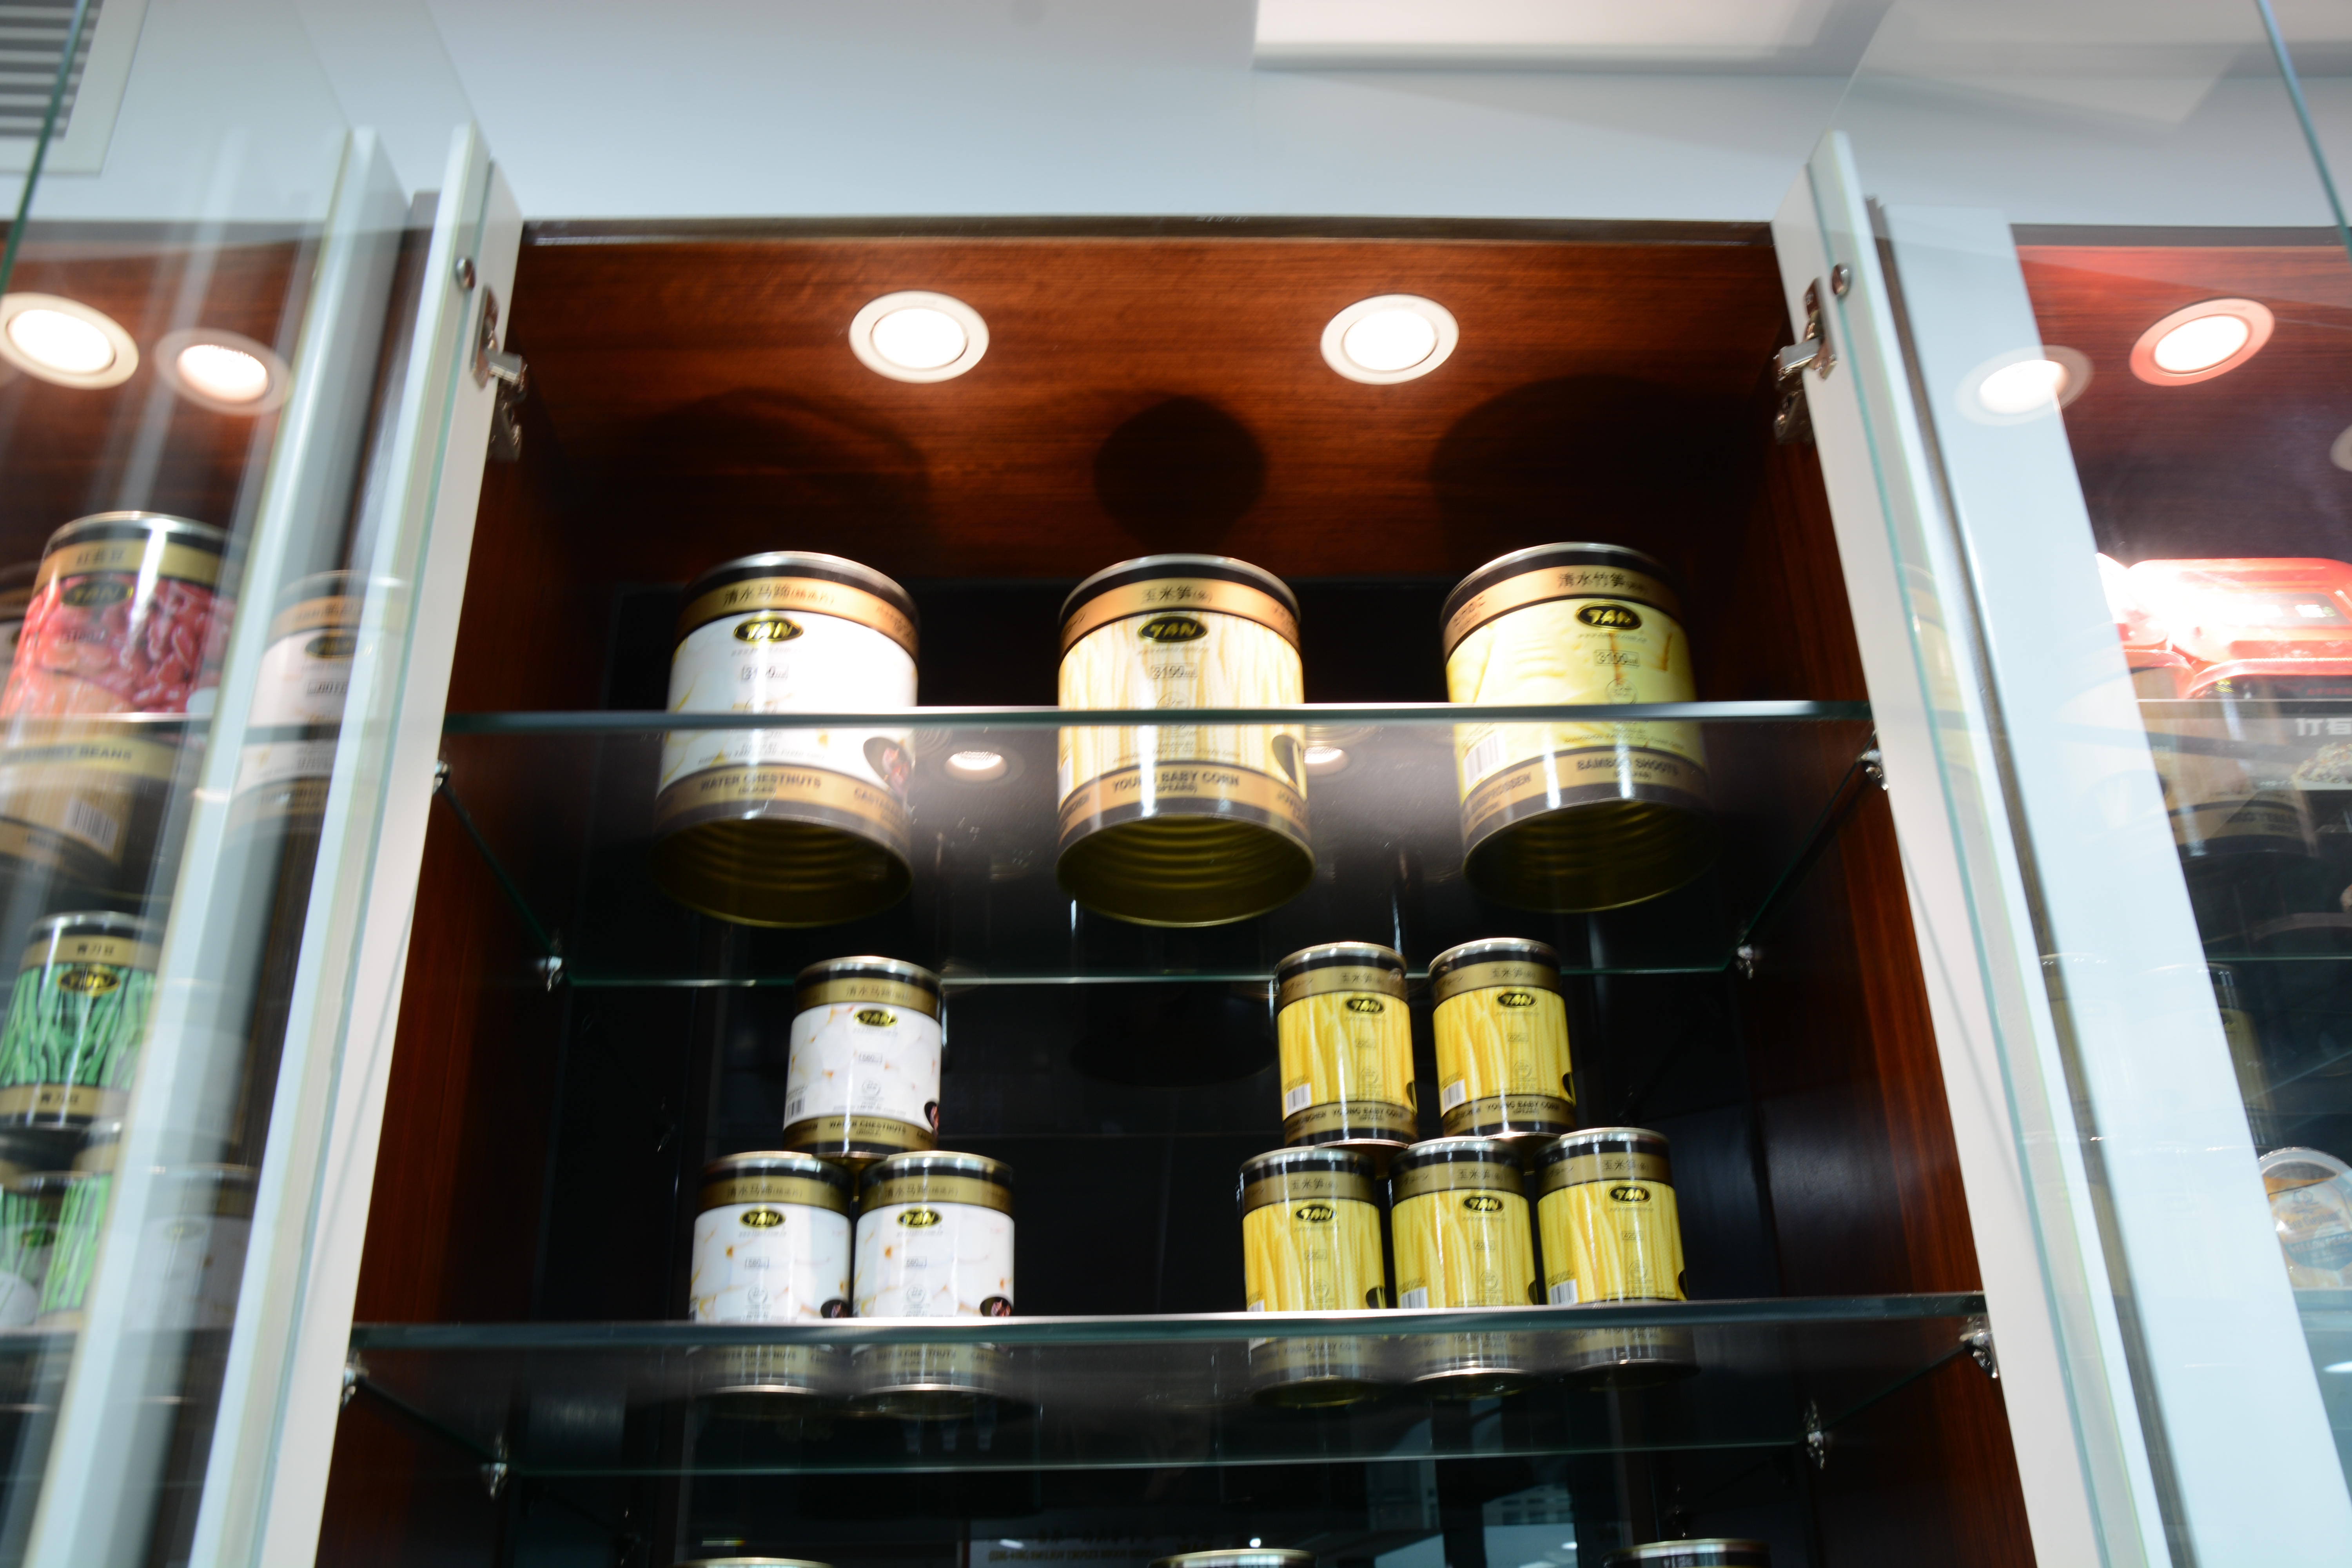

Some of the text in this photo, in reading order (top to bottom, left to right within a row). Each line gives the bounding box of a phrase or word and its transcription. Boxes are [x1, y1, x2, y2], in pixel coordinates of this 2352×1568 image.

[1587, 610, 1633, 625] TAN
[746, 622, 793, 640] TAN
[1149, 622, 1198, 638] TAN
[1577, 757, 1632, 771] BAMB
[1162, 771, 1198, 782] BABY
[1202, 771, 1239, 786] CORN
[1352, 1000, 1380, 1011] TAN
[1502, 995, 1532, 1005] TAN
[1541, 1102, 1560, 1110] CORN
[1333, 1107, 1361, 1117] YONG
[1387, 1108, 1403, 1118] CORN
[860, 1119, 906, 1134] CHESTNUTS
[1615, 1189, 1645, 1200] TAN
[1469, 1198, 1498, 1210] TAN
[748, 1212, 779, 1225] TAN
[904, 1212, 935, 1225] TAN
[1301, 1208, 1333, 1220] TAN
[904, 1349, 956, 1360] CHETNUTS
